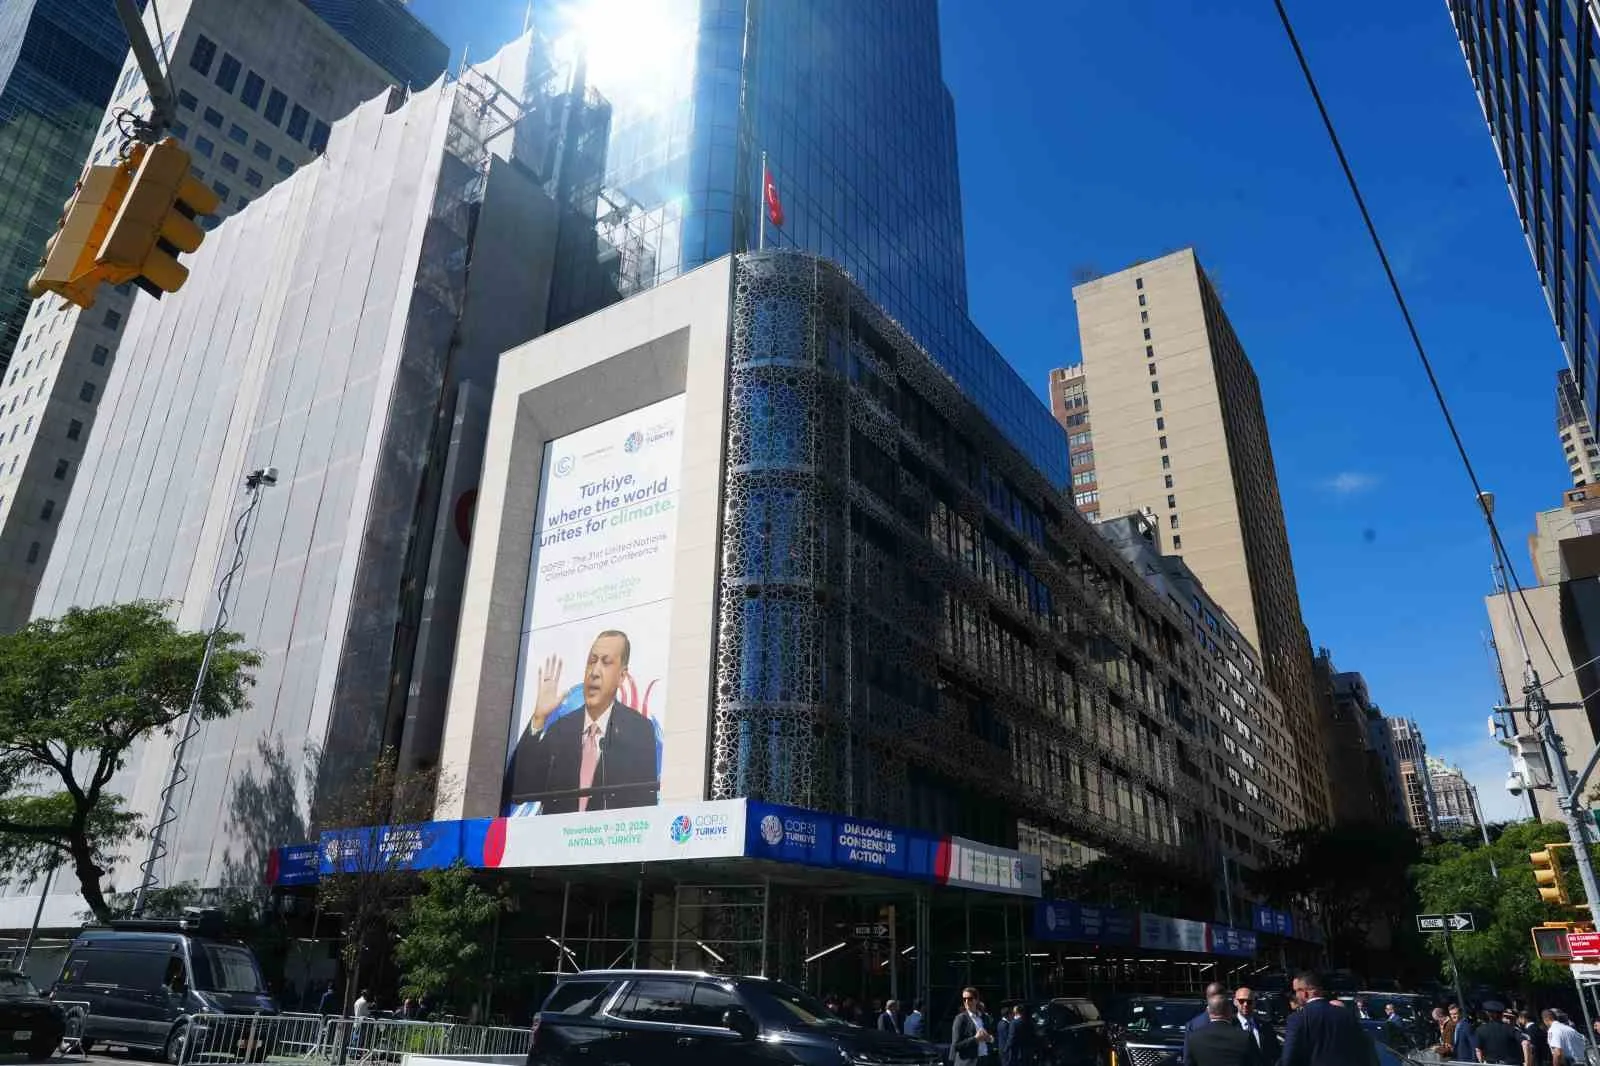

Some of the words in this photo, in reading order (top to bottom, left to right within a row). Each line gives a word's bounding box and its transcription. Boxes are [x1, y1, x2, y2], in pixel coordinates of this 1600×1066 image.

[580, 473, 636, 499] Türkiye,
[549, 505, 592, 527] where
[596, 496, 620, 512] the
[624, 475, 668, 503] world
[540, 527, 583, 548] unites
[586, 516, 607, 534] for
[610, 498, 675, 526] climate.
[633, 532, 667, 547] Nations
[577, 557, 609, 574] Change
[562, 823, 602, 835] November
[784, 818, 816, 835] COP31
[844, 823, 893, 840] DIALOGUE
[839, 836, 896, 853] CONSENSUS
[849, 850, 886, 865] ACTION
[1424, 919, 1440, 927] ONE
